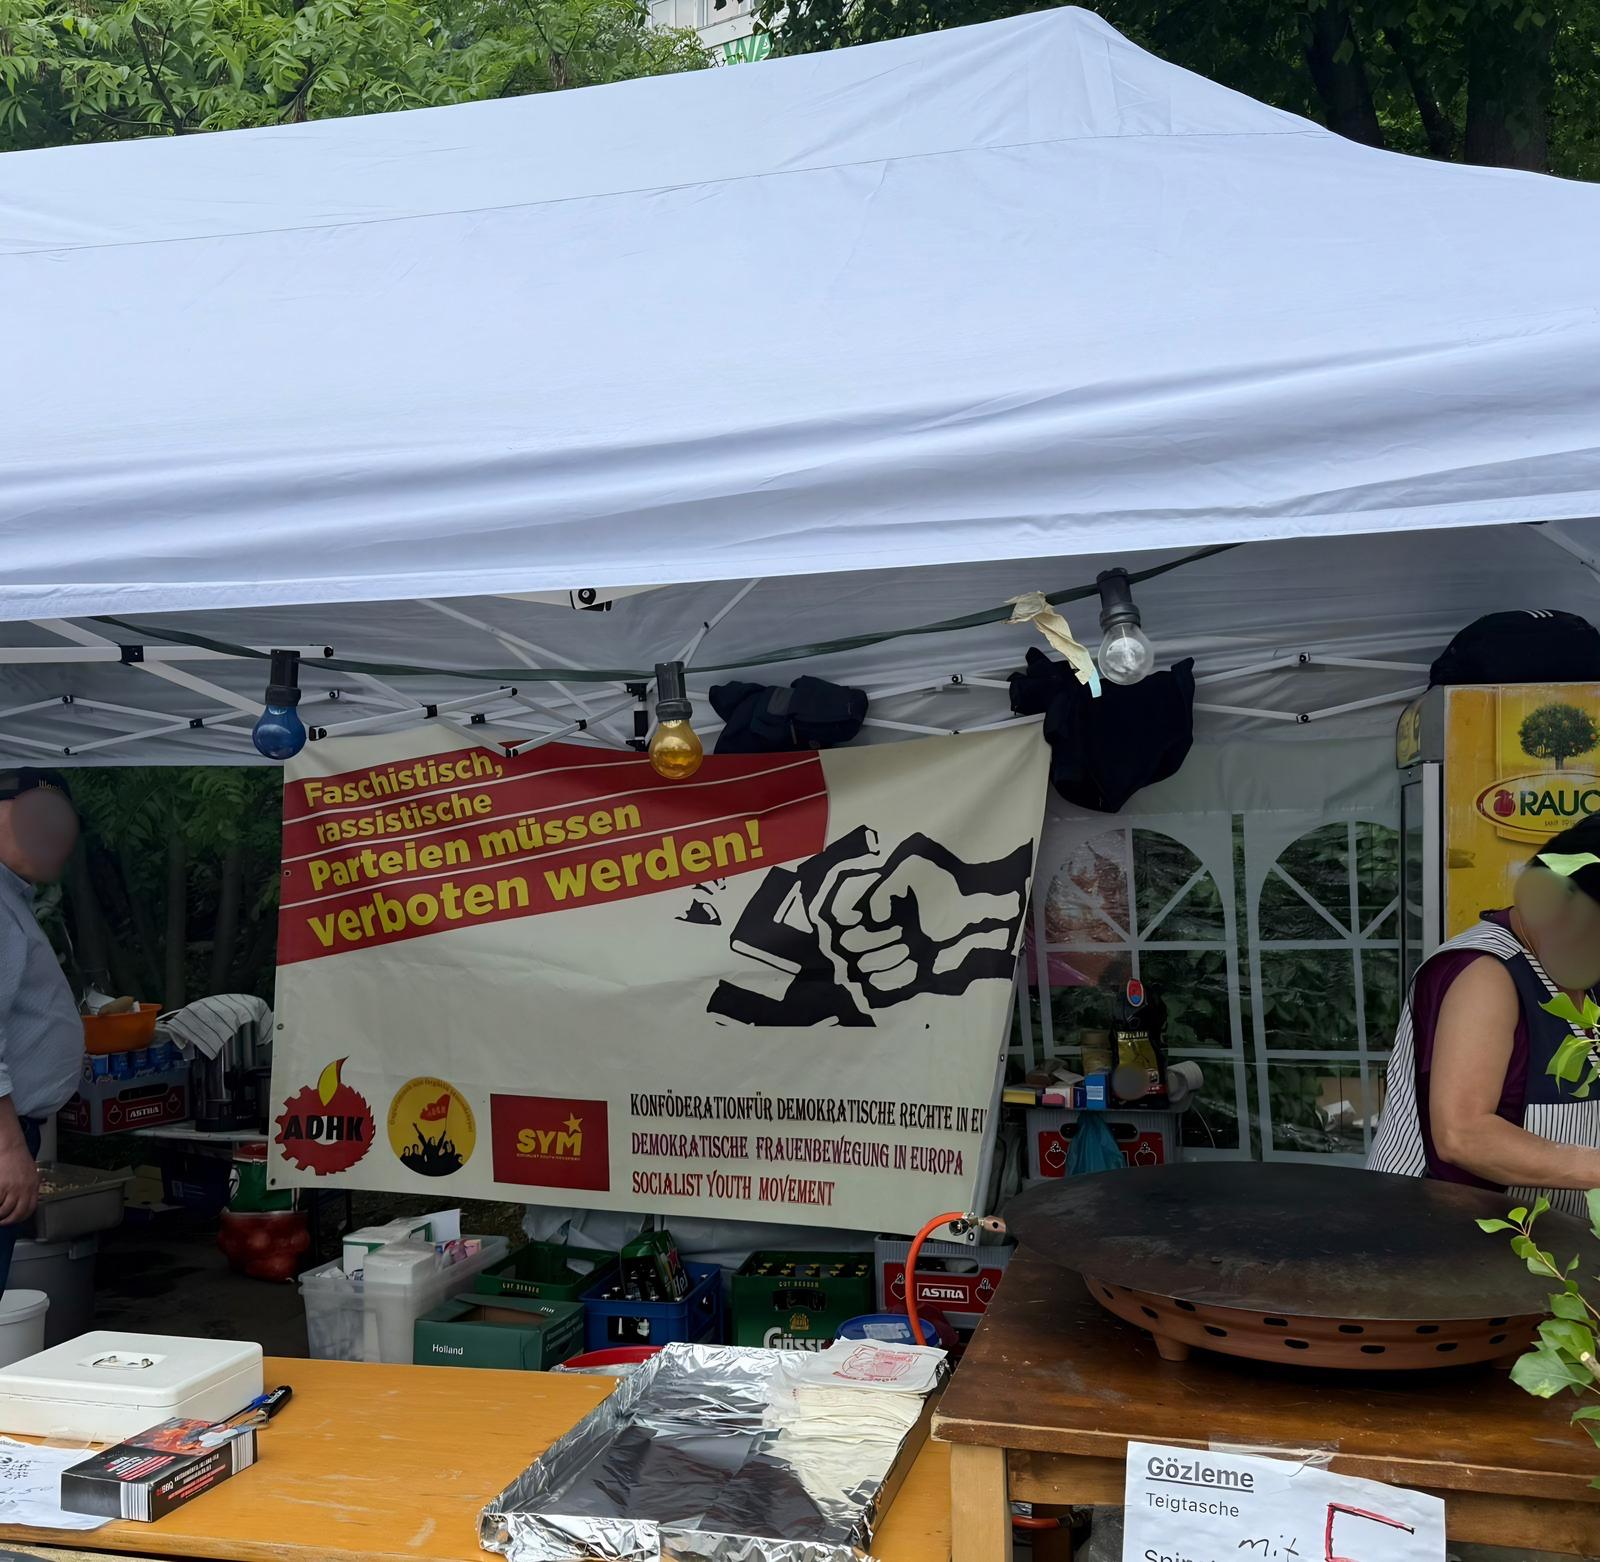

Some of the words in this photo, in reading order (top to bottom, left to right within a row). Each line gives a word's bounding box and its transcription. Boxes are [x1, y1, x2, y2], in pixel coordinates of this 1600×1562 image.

[304, 751, 505, 807] Faschistisch,
[315, 794, 493, 845] rassistische
[309, 834, 471, 892] Parteien
[480, 802, 642, 860] müssen
[306, 876, 530, 948] verboten
[544, 818, 765, 903] werden!
[283, 1113, 364, 1144] ADHK
[777, 1097, 896, 1126] DEMOKRATISCHE
[899, 1102, 953, 1130] RECHTE
[956, 1106, 969, 1133] IN
[516, 1128, 583, 1157] SYM
[631, 1131, 749, 1159] DEMOKRATISCHE
[755, 1135, 889, 1169] FRAUENBEWEGUNG
[893, 1144, 906, 1170] IN
[910, 1145, 964, 1177] EUROPA
[632, 1170, 703, 1197] SOCIALIST
[705, 1169, 752, 1201] YOUTH
[758, 1173, 836, 1206] MOVEMENT
[921, 1287, 965, 1299] ASTRA
[432, 1343, 464, 1356] Holland
[1147, 1456, 1254, 1488] Gözleme
[1146, 1492, 1239, 1518] Teigtasche
